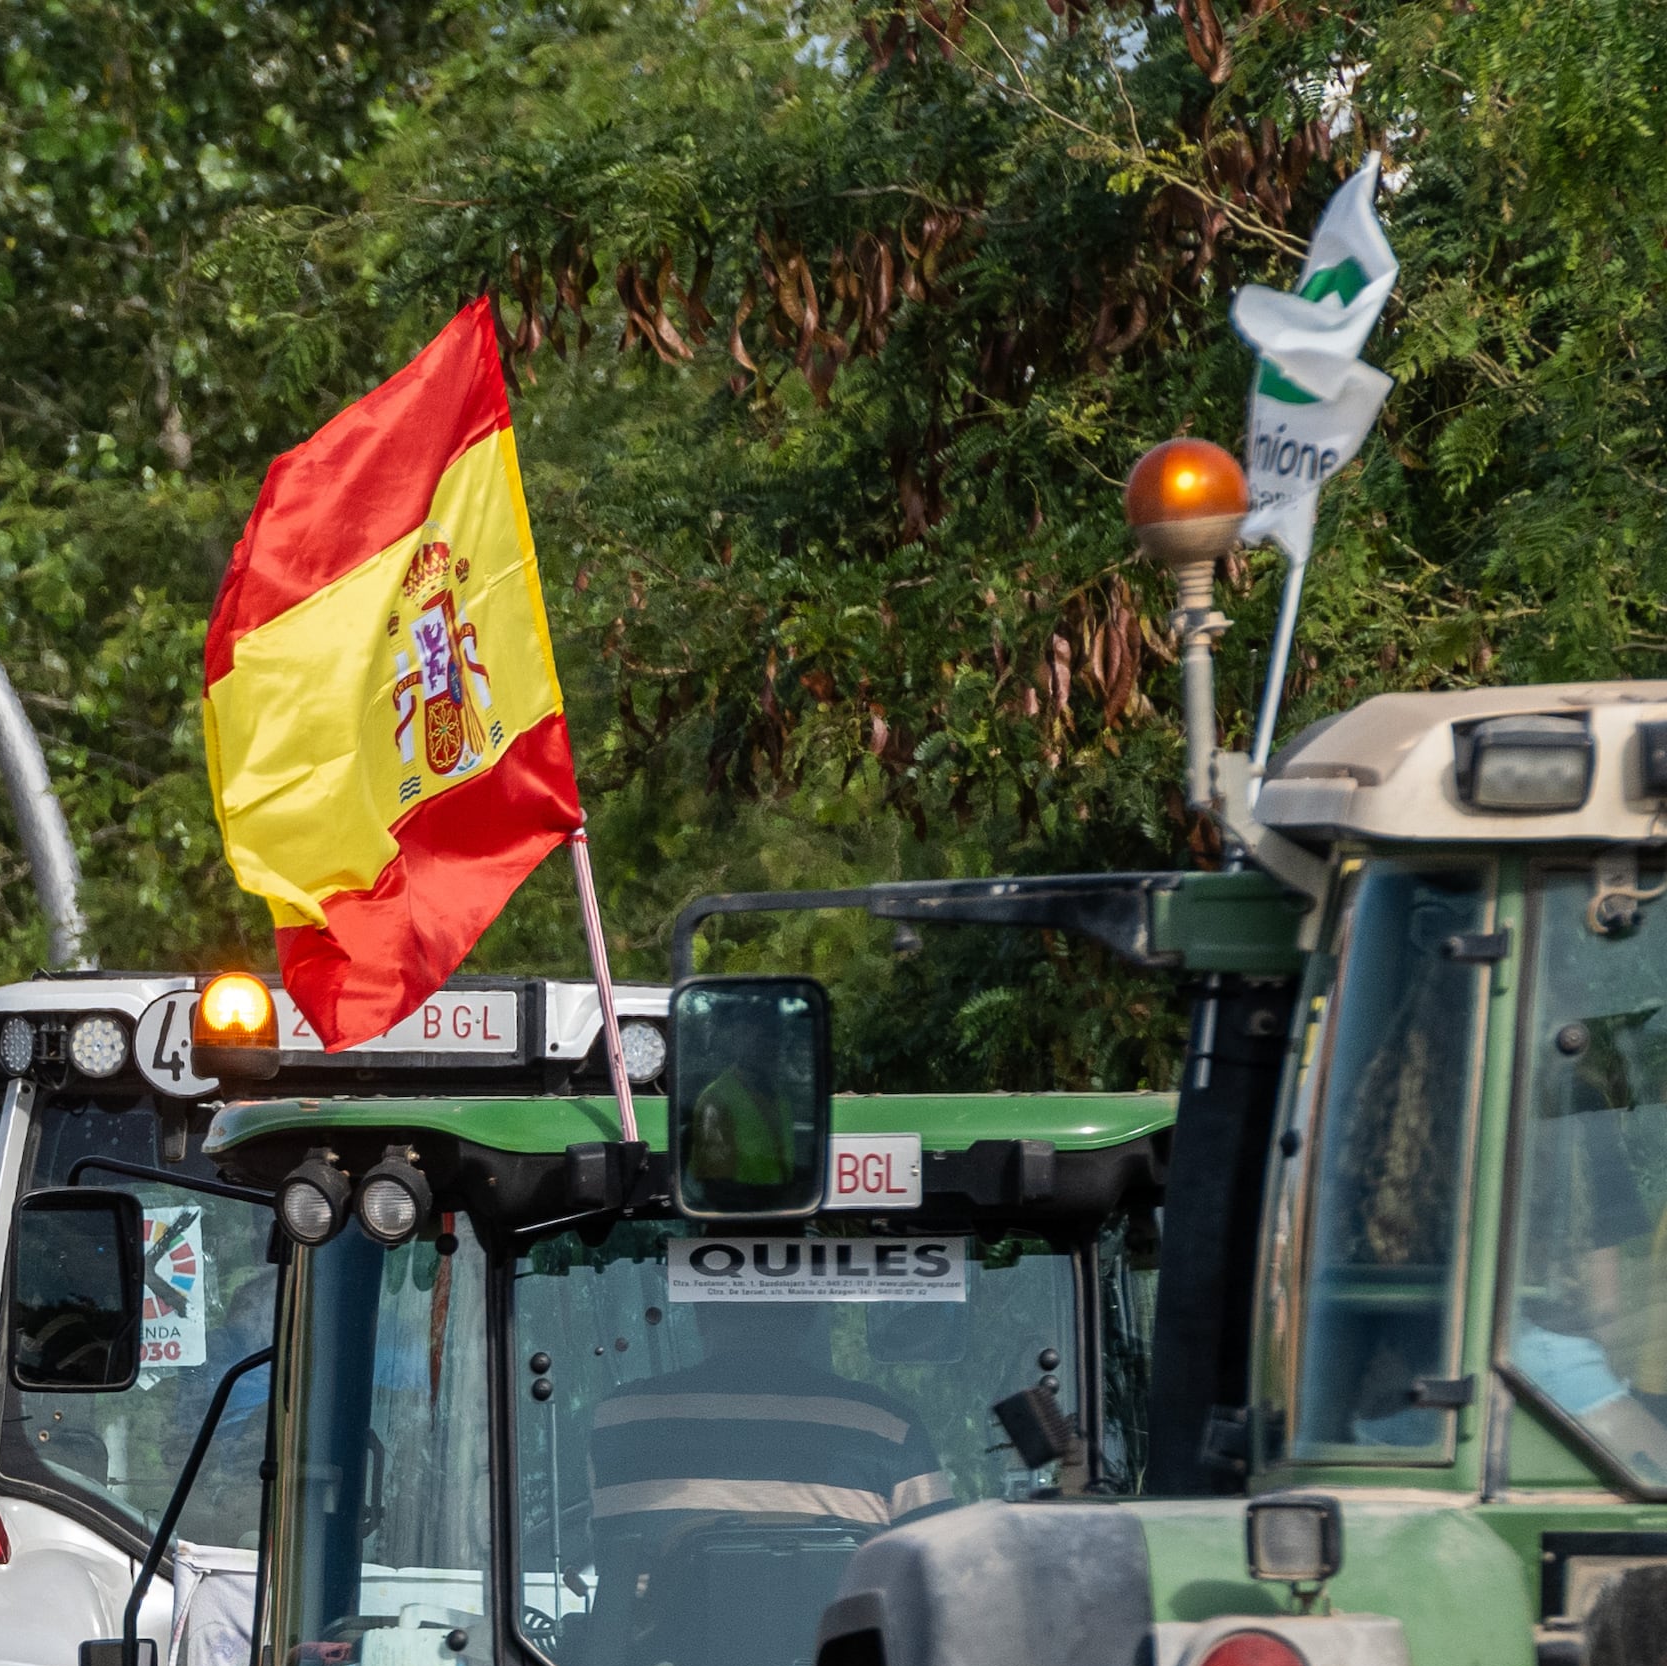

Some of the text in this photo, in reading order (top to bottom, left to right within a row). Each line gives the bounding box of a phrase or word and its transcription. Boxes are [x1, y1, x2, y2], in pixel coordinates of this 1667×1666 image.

[152, 1000, 199, 1082] 4
[423, 1004, 501, 1041] BGL
[837, 1152, 908, 1194] BGL
[688, 1243, 952, 1278] QUILES
